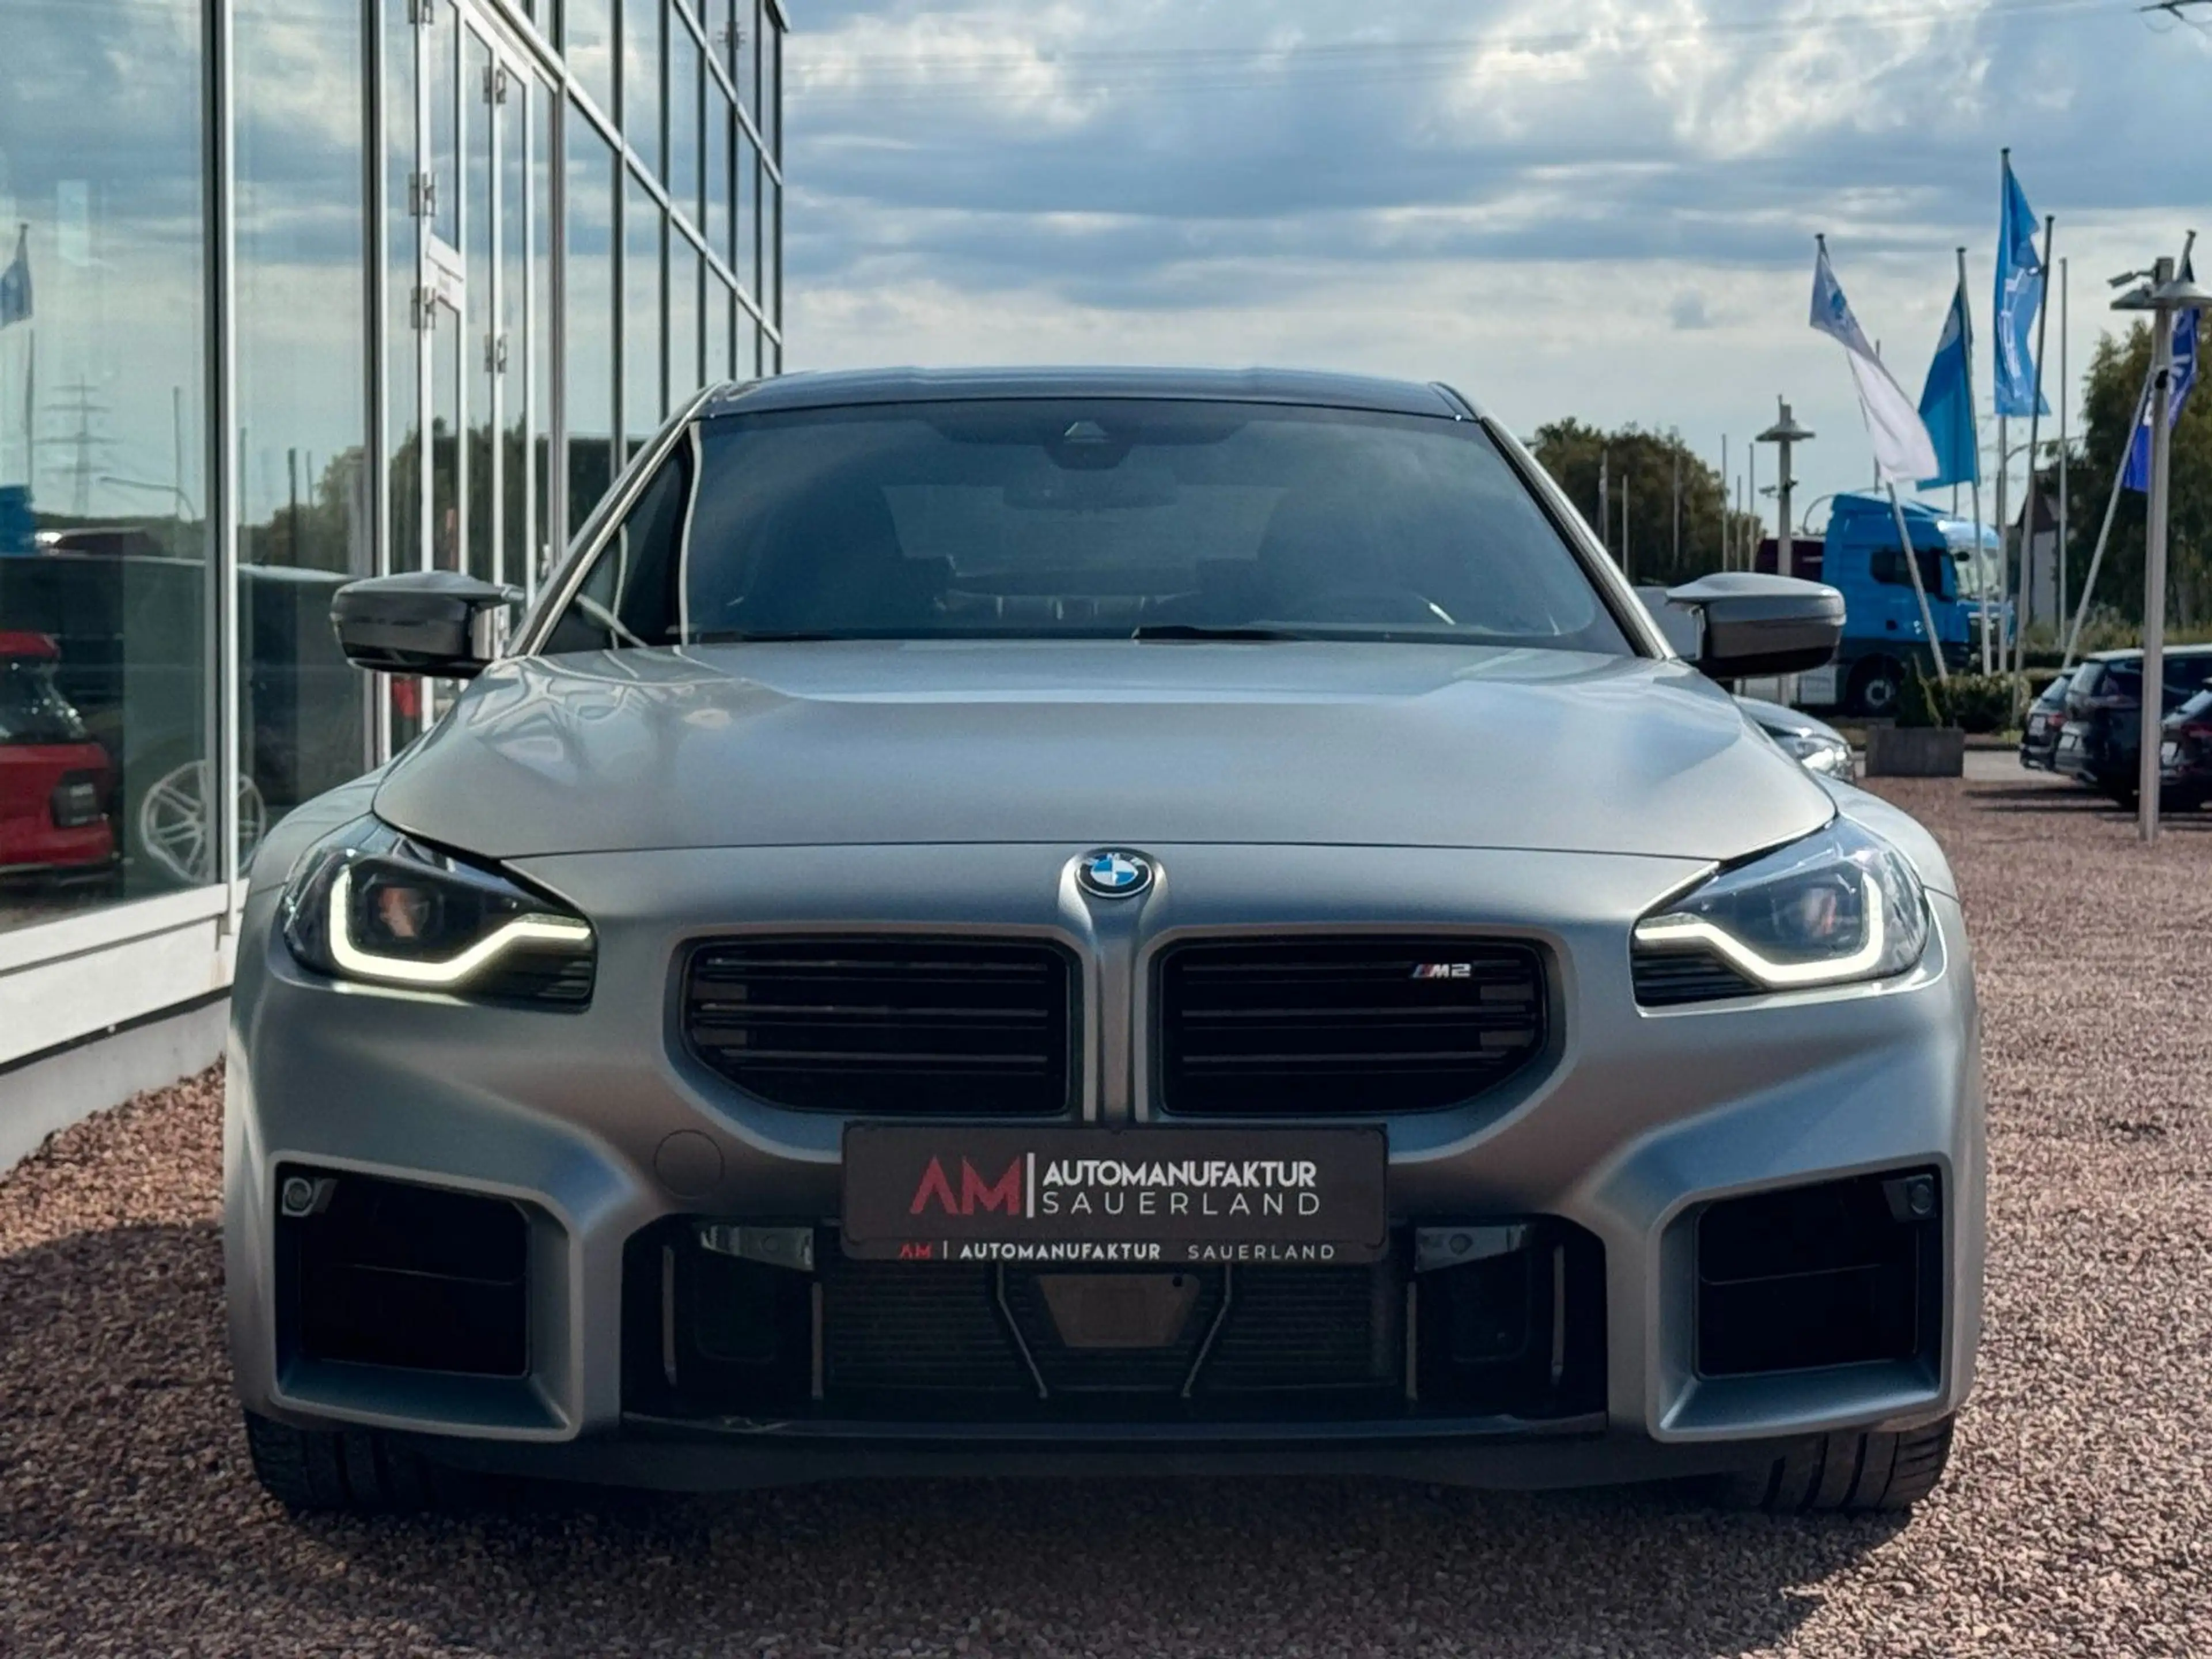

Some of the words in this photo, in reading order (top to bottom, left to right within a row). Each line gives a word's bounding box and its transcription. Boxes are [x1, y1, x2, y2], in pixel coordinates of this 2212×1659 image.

[1429, 963, 1472, 978] M2
[910, 1155, 1021, 1215] AM
[1042, 1160, 1317, 1188] AUTOMANUFAKTUR
[1042, 1191, 1320, 1215] SAUERLAND
[959, 1242, 1161, 1260] AUTOMANUFAKTUR
[1187, 1244, 1335, 1260] SAUERLAND
